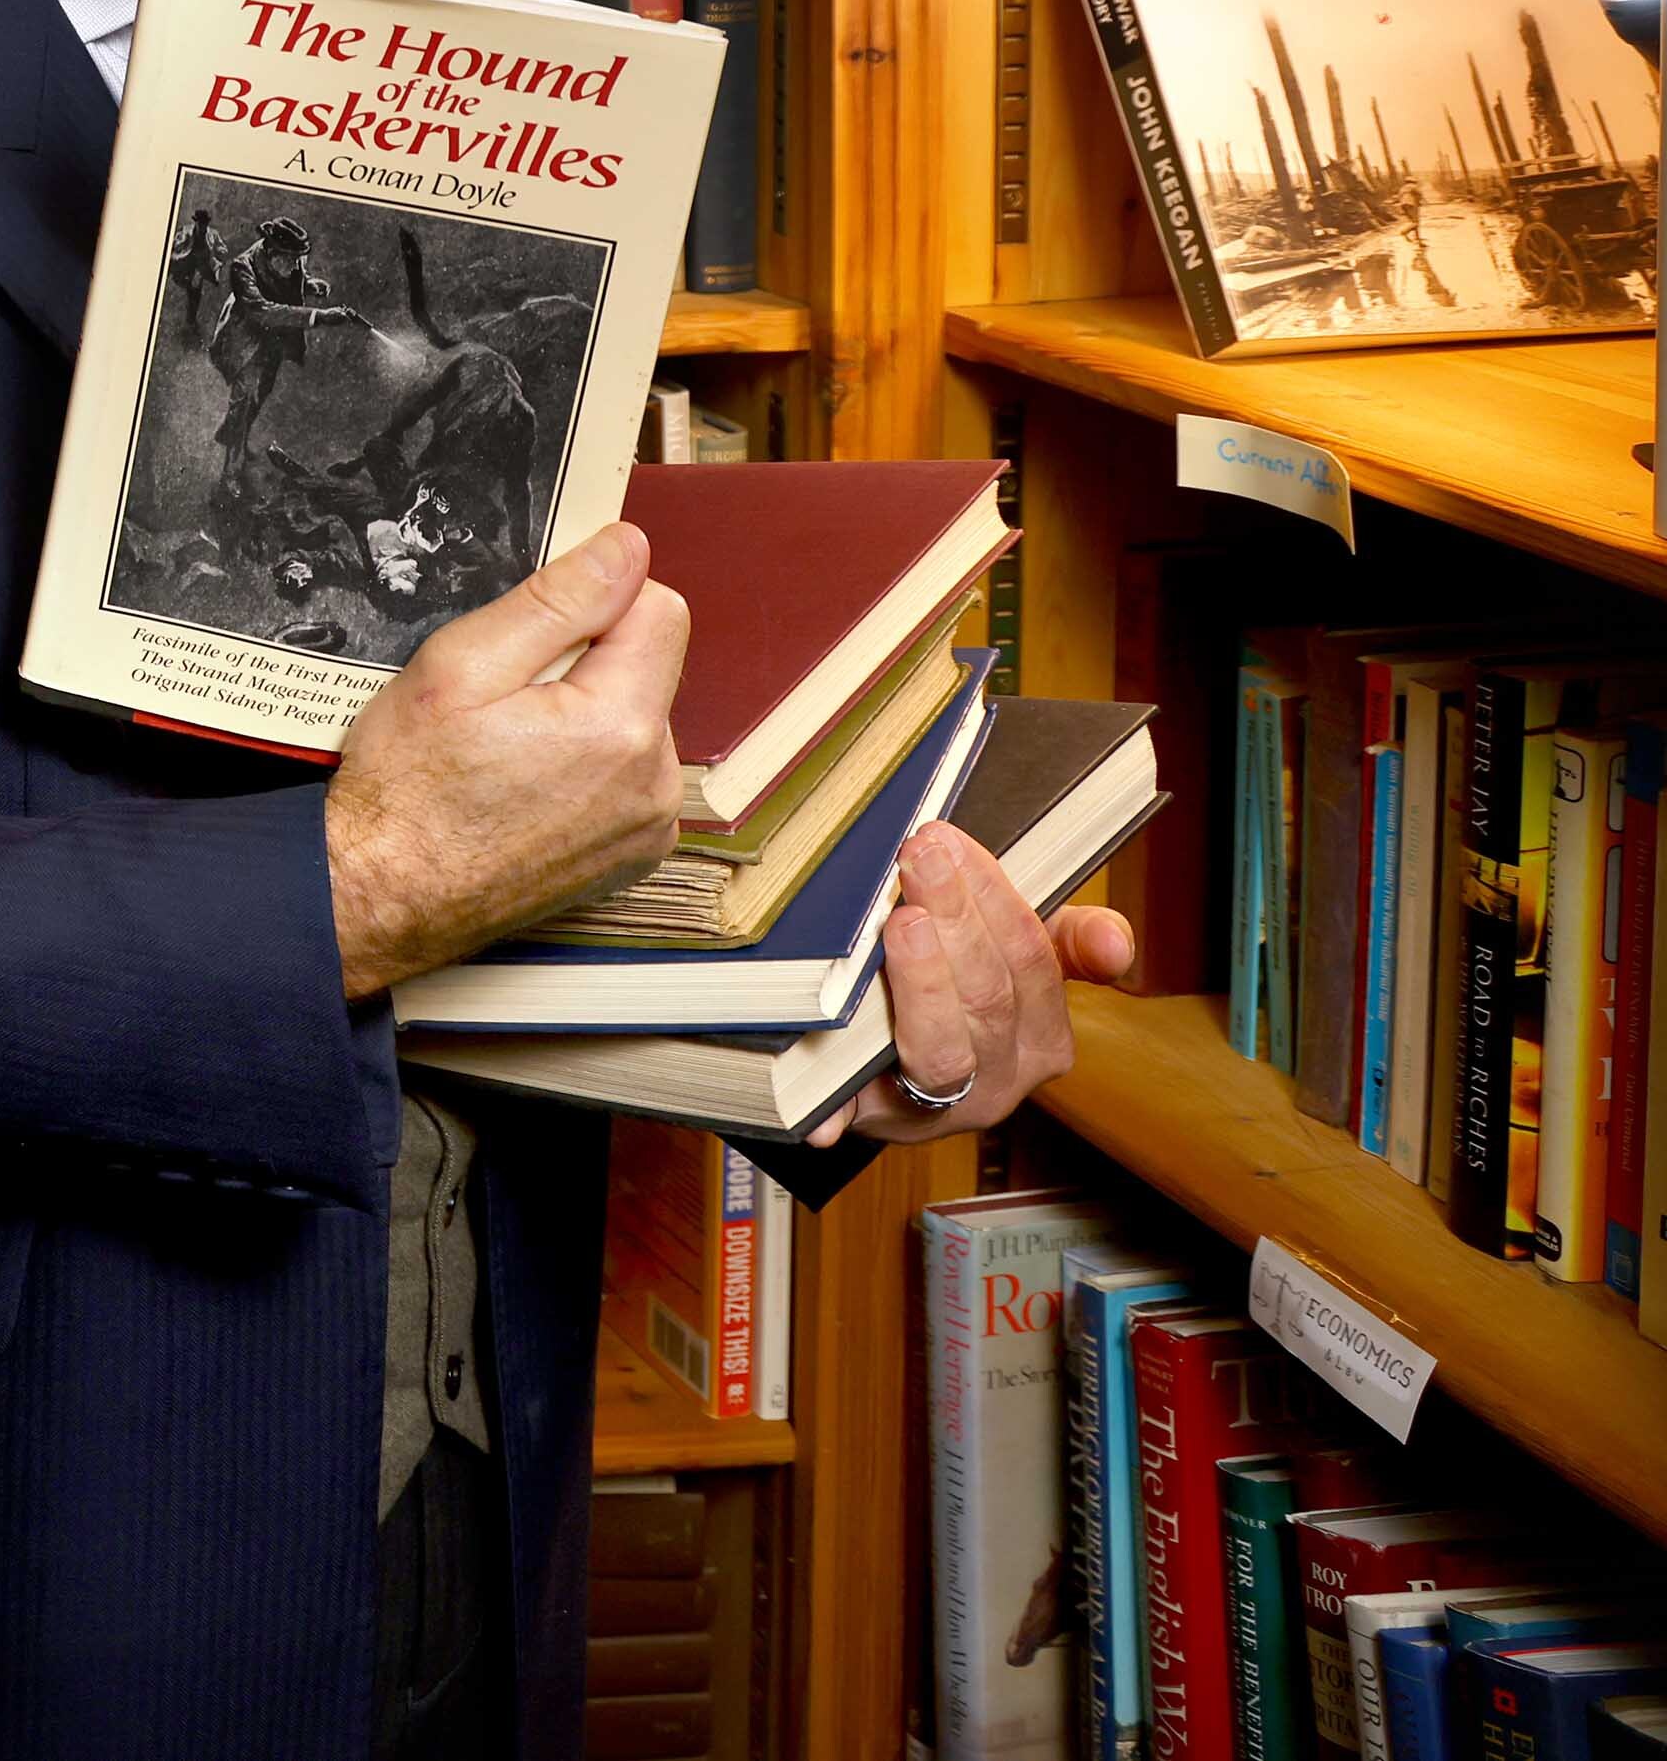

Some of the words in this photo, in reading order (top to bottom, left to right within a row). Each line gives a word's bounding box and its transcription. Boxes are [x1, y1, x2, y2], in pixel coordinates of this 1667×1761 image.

[240, 0, 368, 63] The
[379, 24, 629, 108] Hound
[199, 75, 624, 191] Baskervilles
[378, 78, 417, 117] of
[422, 84, 482, 118] the
[285, 150, 315, 175] A.
[328, 158, 424, 191] Conan
[433, 174, 519, 210] Doyle
[1128, 74, 1166, 152] JOHN
[1154, 154, 1203, 272] KEEGAN
[131, 668, 209, 699] Original
[215, 688, 280, 717] Sidney
[285, 704, 337, 727] Paget
[132, 627, 222, 657] Facsimile
[226, 648, 248, 669] of
[251, 654, 281, 672] the
[285, 662, 327, 684] First
[141, 649, 173, 667] The
[176, 659, 241, 685] Strand
[247, 676, 341, 706] Magazine
[1473, 944, 1493, 1030] ROAD
[1468, 1062, 1492, 1173] RICHES
[725, 1226, 752, 1323] DOWNSIZE
[723, 1329, 749, 1380] THIS!
[1307, 1298, 1416, 1390] ECONOMICS
